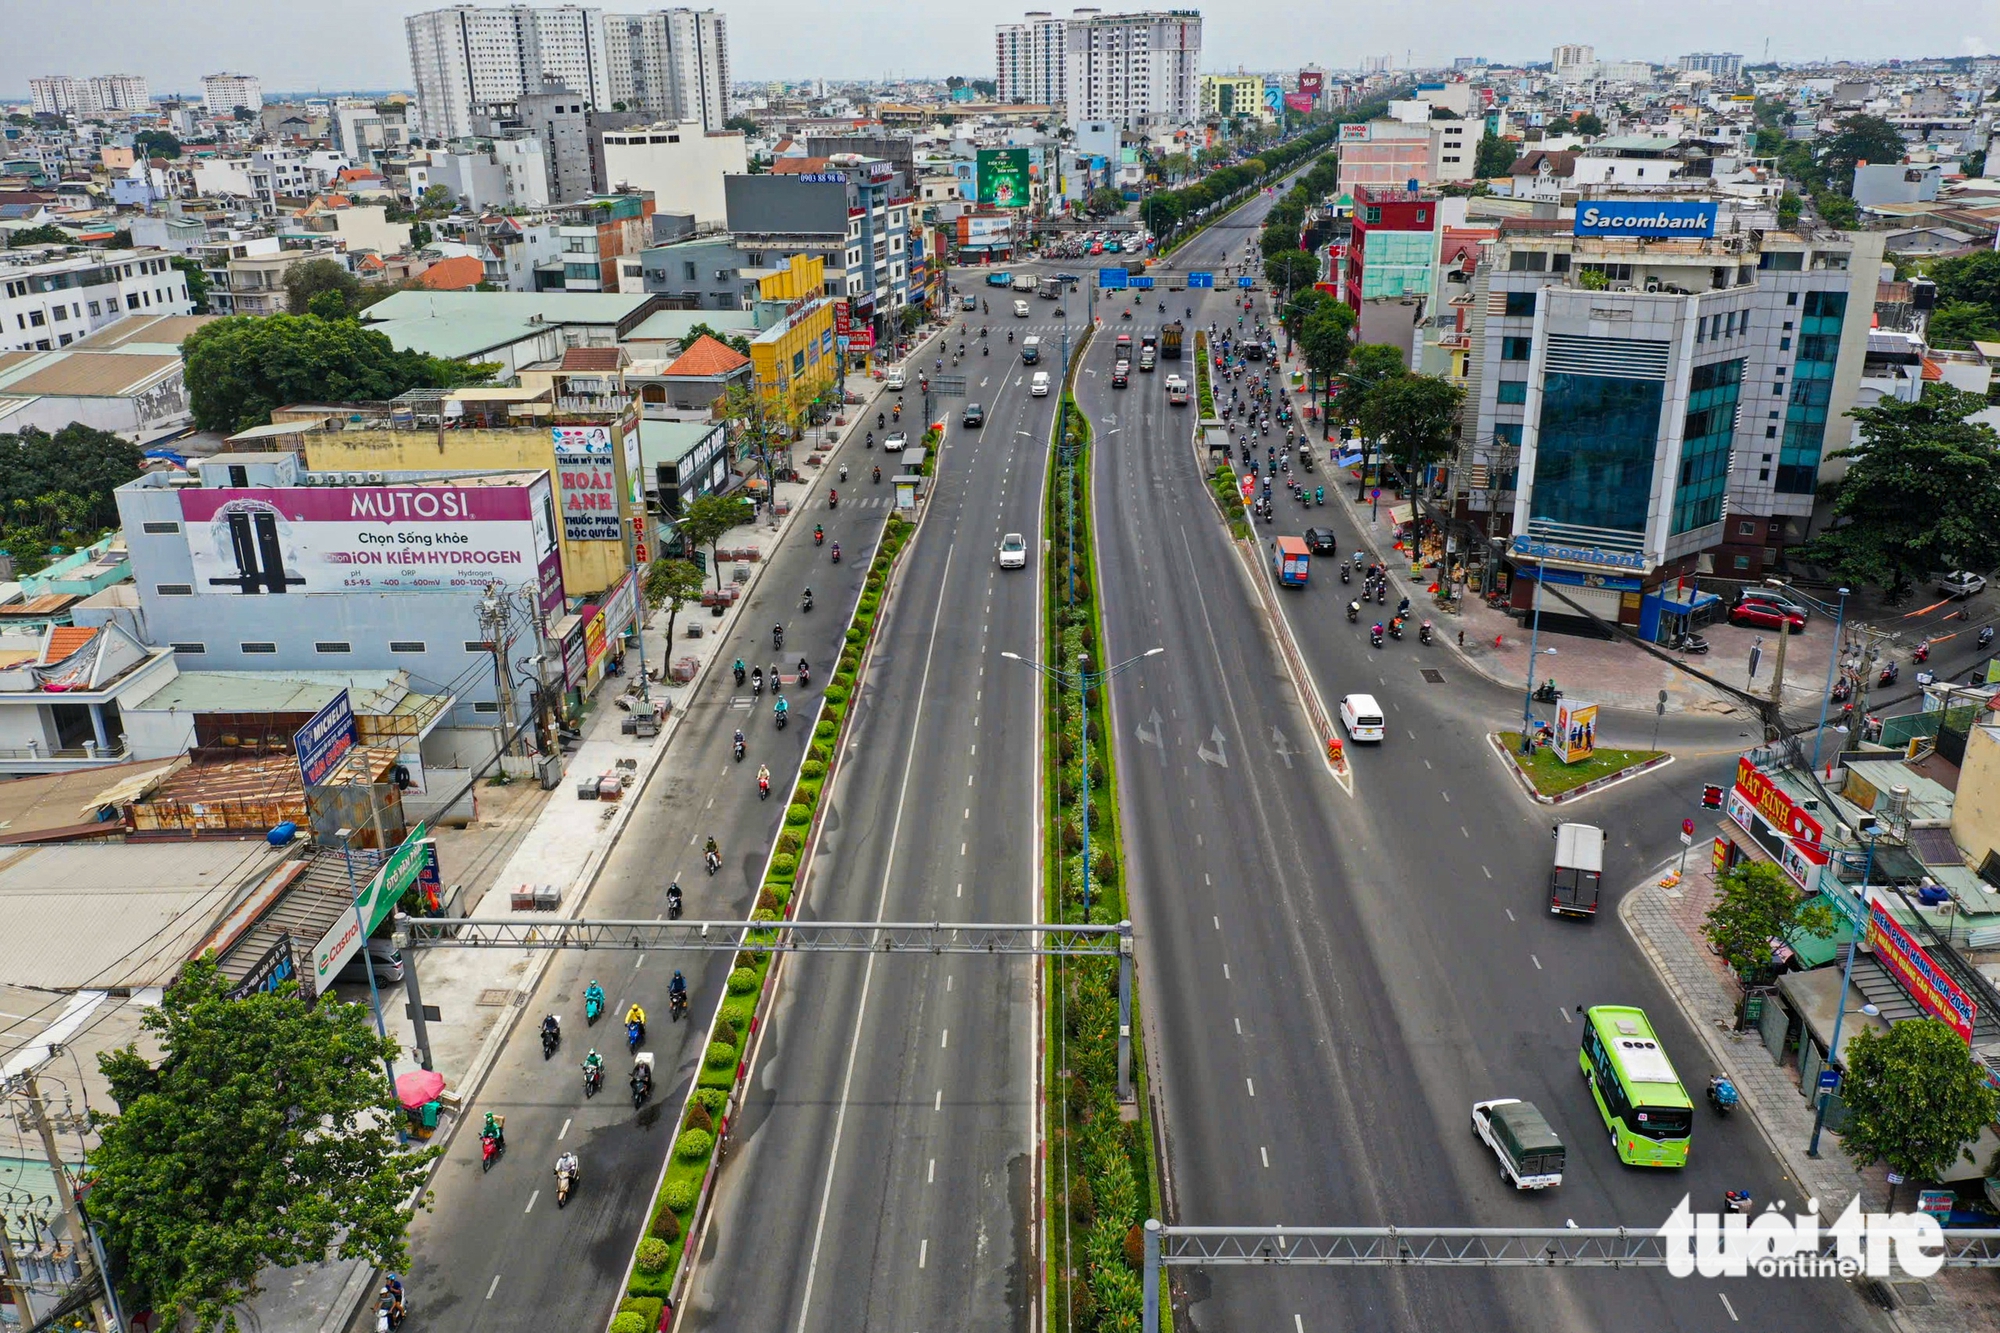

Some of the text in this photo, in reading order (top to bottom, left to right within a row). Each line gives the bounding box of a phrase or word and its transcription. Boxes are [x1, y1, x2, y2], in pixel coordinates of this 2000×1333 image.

[870, 162, 892, 176] KARAOKE
[1582, 208, 1708, 229] Sacombank
[558, 454, 612, 466] THẨM MỸ VIỆN
[562, 466, 613, 490] HOÀI
[351, 492, 468, 517] MUTOSI
[568, 492, 612, 511] ANH
[564, 514, 619, 526] THUỐC PHUN
[358, 530, 468, 546] Chọn Sống khỏe
[568, 526, 618, 538] ĐỘC QUYỀN
[387, 547, 426, 564] KIỀM
[428, 550, 522, 564] HYDROGEN
[636, 544, 646, 562] ANH
[1513, 534, 1646, 570] Sacombank
[458, 570, 493, 578] Hydrogen
[313, 698, 347, 742] MICHELIN
[1737, 764, 1760, 797] MẮT
[1761, 786, 1791, 825] KÍNH
[328, 920, 360, 961] Castrol
[269, 956, 276, 968] XE
[280, 944, 287, 954] TÔ
[1874, 909, 1891, 936] ĐIỂM
[1890, 930, 1910, 956] PHÁT
[1910, 950, 1932, 979] HÀNH
[1930, 970, 1950, 998] LỊCH
[1950, 992, 1971, 1020] 2026
[258, 955, 292, 994] CARE
[1892, 951, 1898, 962] IN
[1898, 956, 1916, 982] QUẢNG
[1916, 976, 1928, 994] CÁO
[1928, 990, 1944, 1012] TRÊN
[1944, 1004, 1958, 1026] LỊCH
